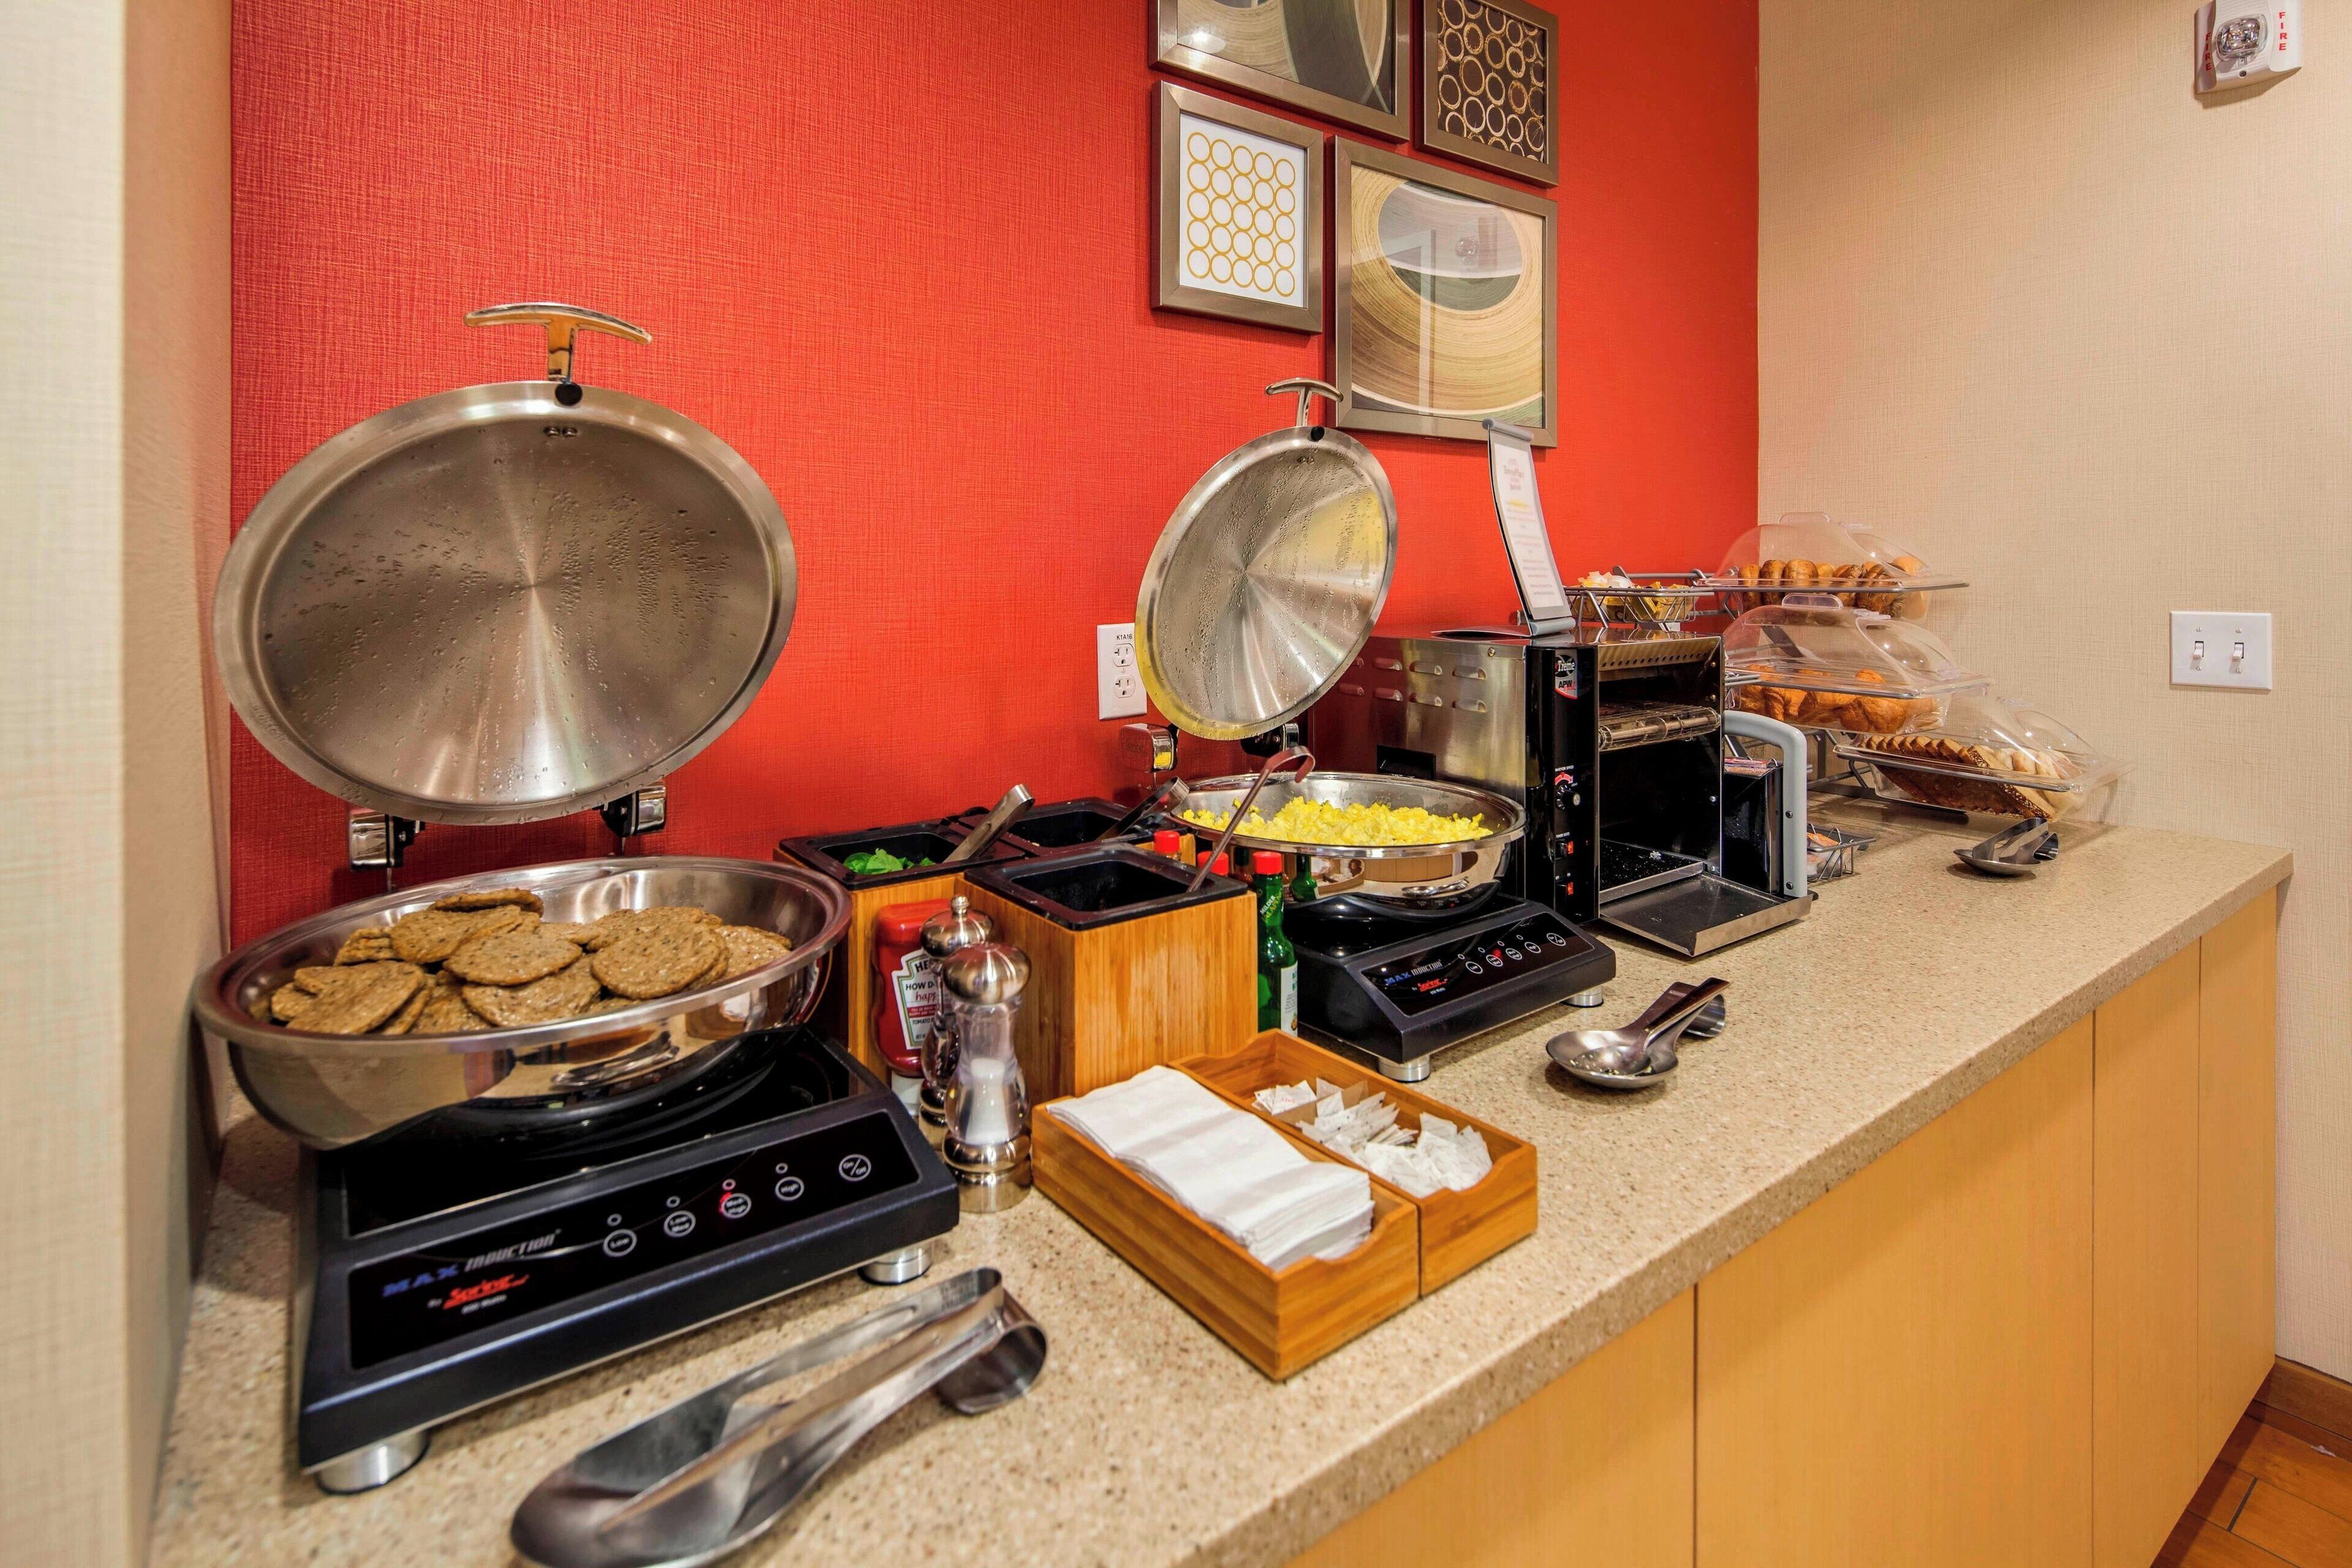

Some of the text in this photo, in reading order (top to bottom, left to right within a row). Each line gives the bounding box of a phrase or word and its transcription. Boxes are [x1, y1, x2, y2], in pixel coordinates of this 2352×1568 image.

[2278, 12, 2288, 51] FIRE
[1559, 680, 1573, 688] APW
[1259, 895, 1276, 916] MILDER
[914, 960, 929, 973] HE
[1384, 971, 1411, 986] MAX
[905, 982, 926, 990] HOW
[609, 1237, 630, 1249] Low
[382, 1264, 459, 1298] MAX
